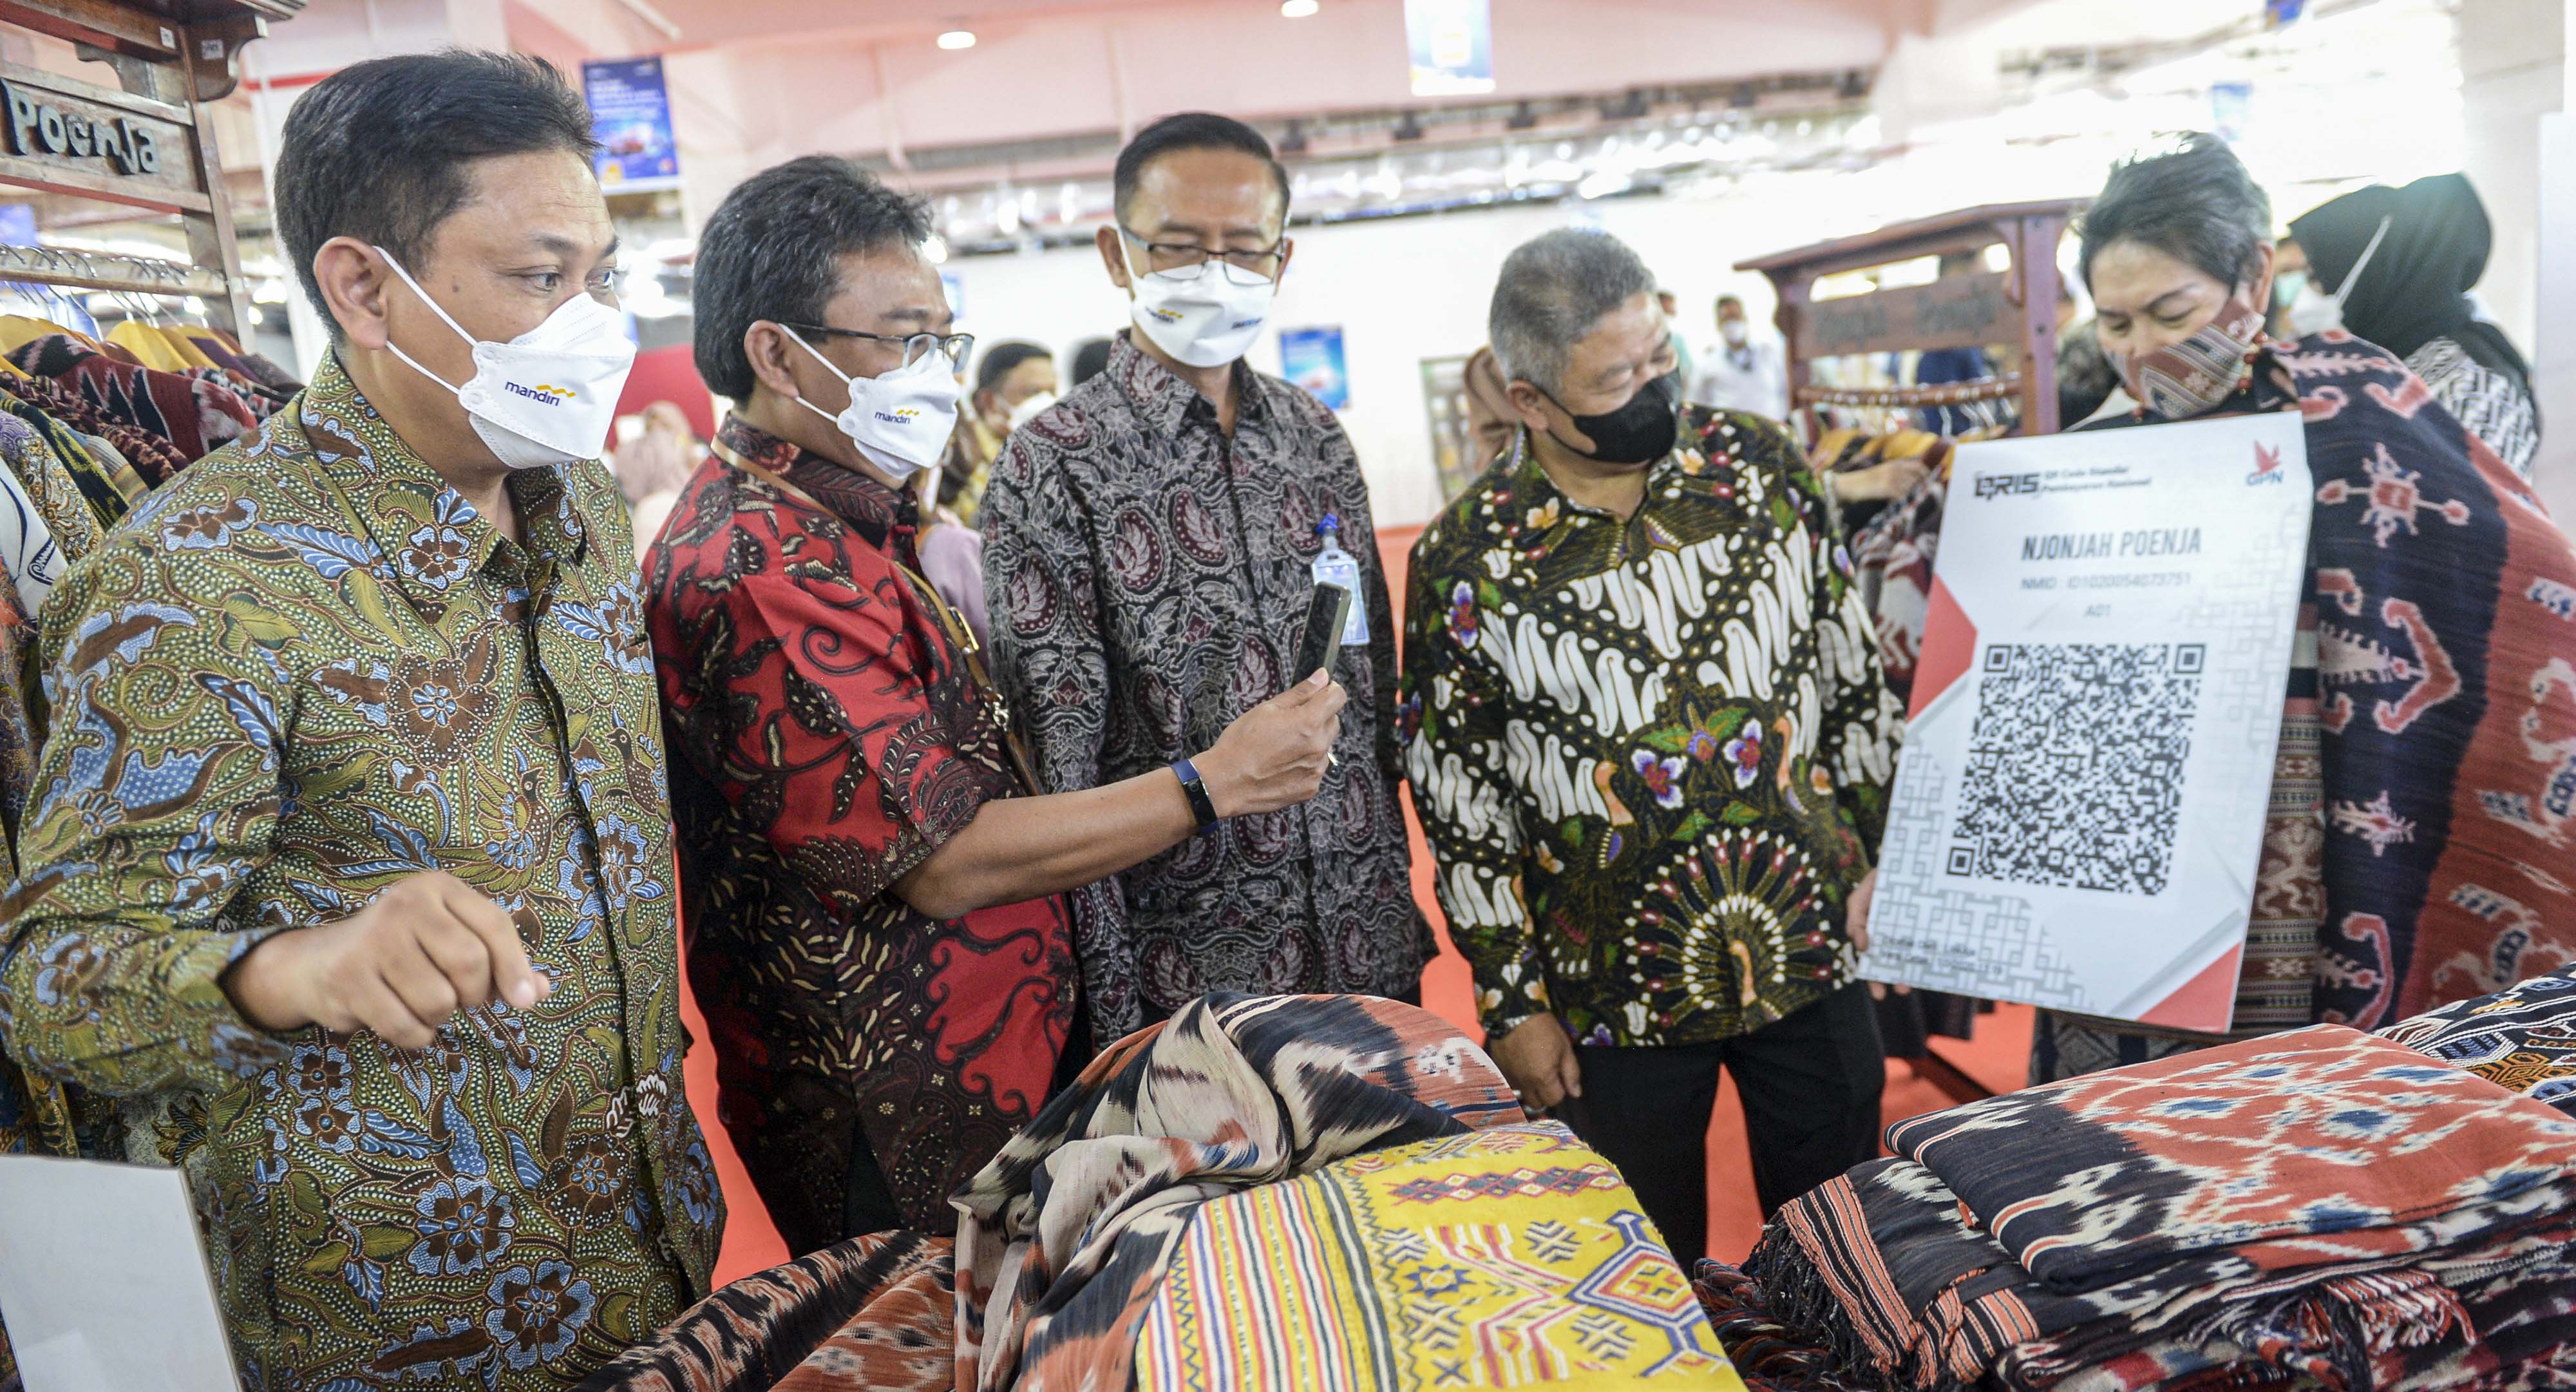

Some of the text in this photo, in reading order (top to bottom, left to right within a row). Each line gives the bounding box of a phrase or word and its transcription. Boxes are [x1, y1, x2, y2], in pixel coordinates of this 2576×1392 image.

[504, 381, 560, 406] mandiri
[875, 412, 911, 424] mandiri
[2021, 527, 2202, 561] NJONJAH POENJA
